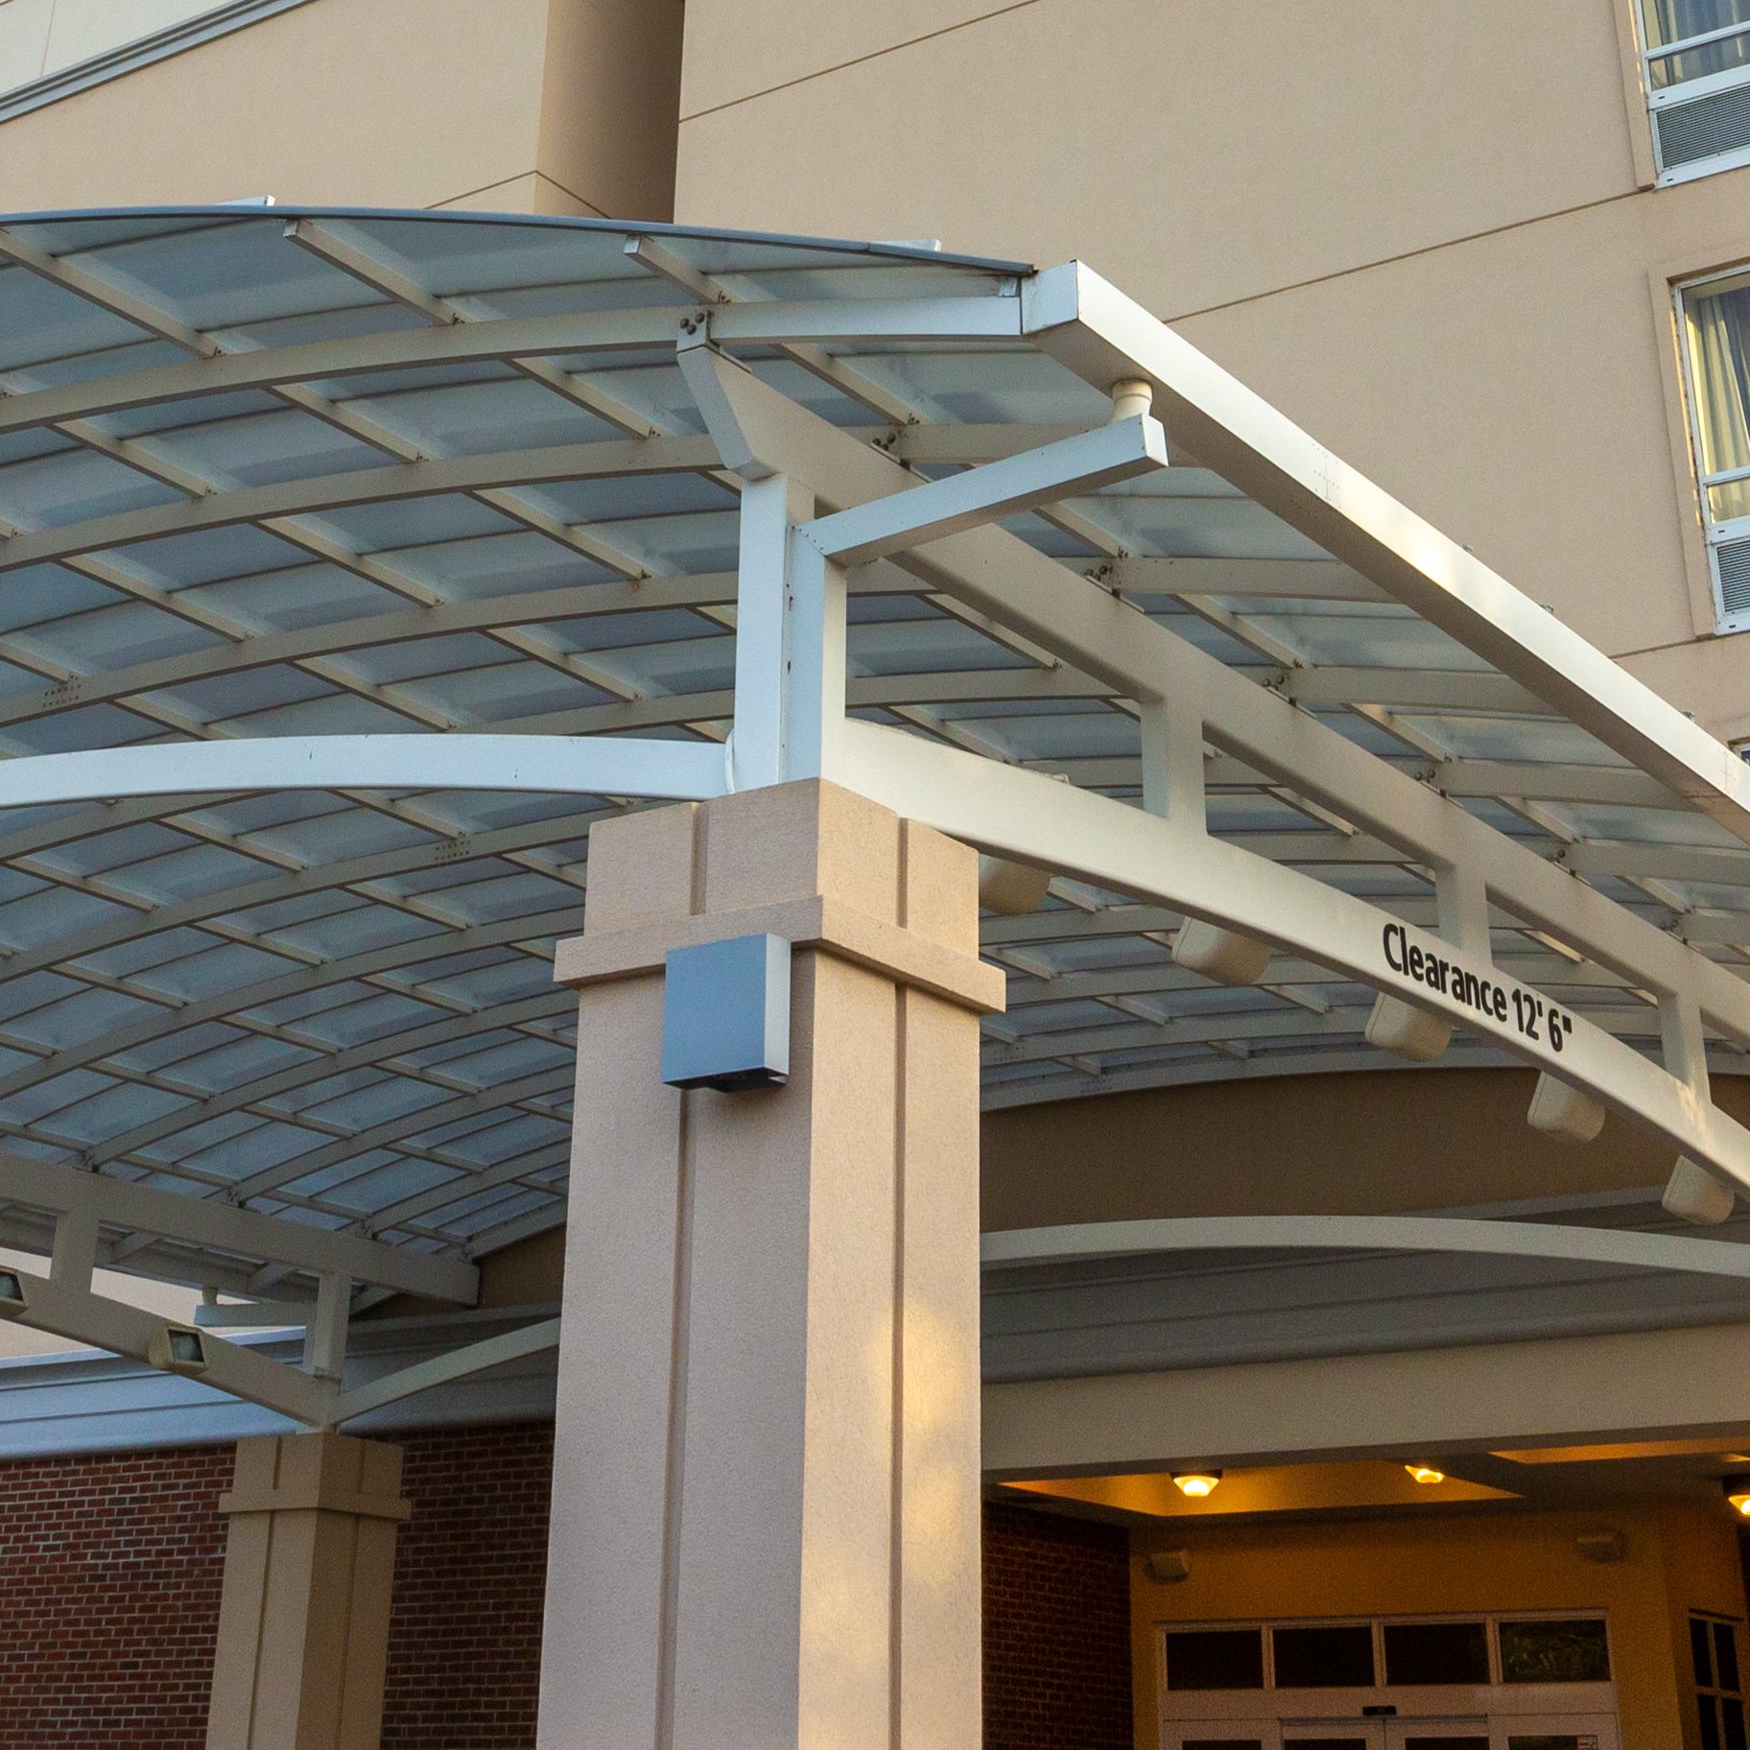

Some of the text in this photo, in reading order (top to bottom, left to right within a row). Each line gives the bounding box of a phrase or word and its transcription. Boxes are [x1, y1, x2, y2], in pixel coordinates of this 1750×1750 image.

[1383, 923, 1572, 1052] Clearance 12' 6"
